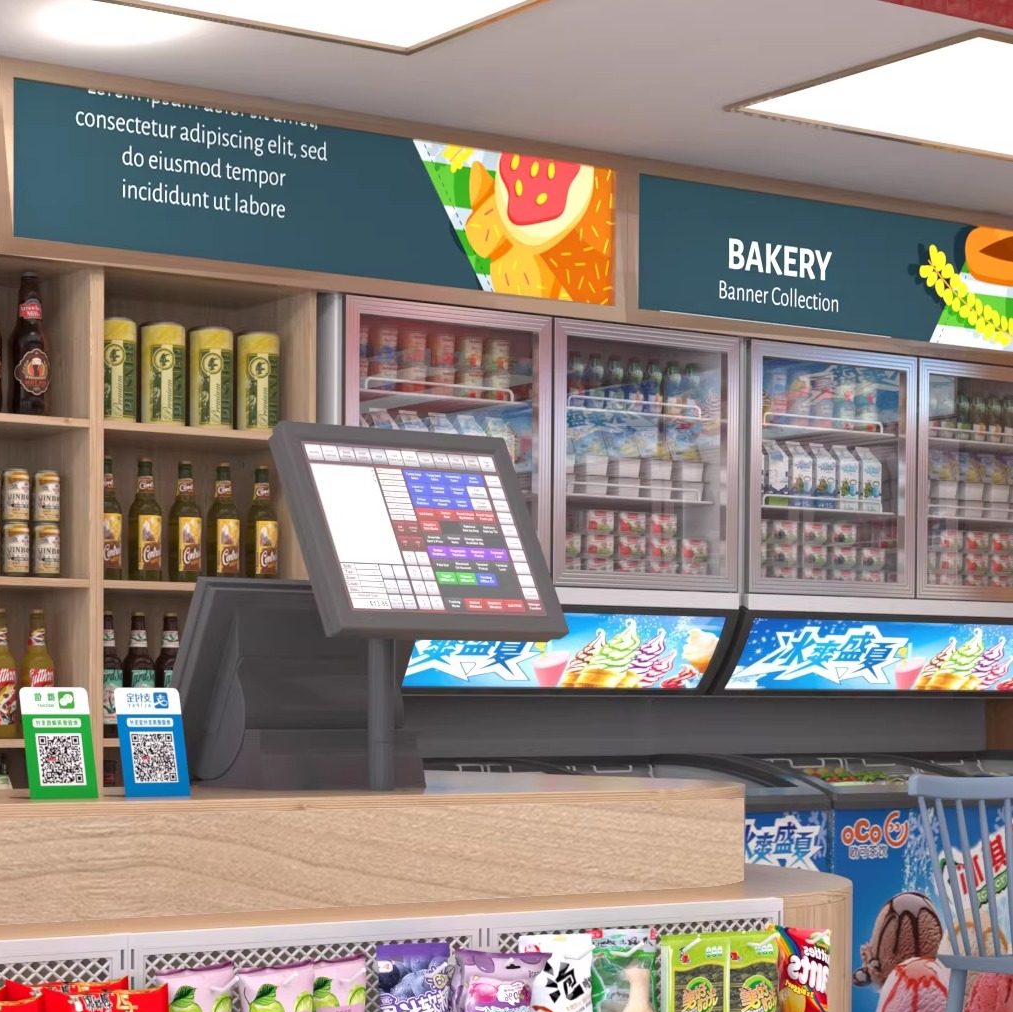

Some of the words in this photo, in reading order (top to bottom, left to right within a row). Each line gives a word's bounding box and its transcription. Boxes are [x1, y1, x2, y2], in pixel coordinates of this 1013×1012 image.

[75, 109, 177, 140] consectetur
[179, 122, 265, 157] adipiscing
[268, 134, 297, 160] elit,
[300, 141, 328, 162] sed
[121, 145, 145, 168] do
[148, 150, 222, 178] eiusmod
[226, 162, 286, 189] tempor
[122, 178, 209, 210] incididunt
[213, 195, 231, 212] ut
[235, 192, 286, 219] labore
[728, 237, 833, 281] BAKERY
[719, 280, 769, 305] Banner
[771, 286, 840, 313] Collection
